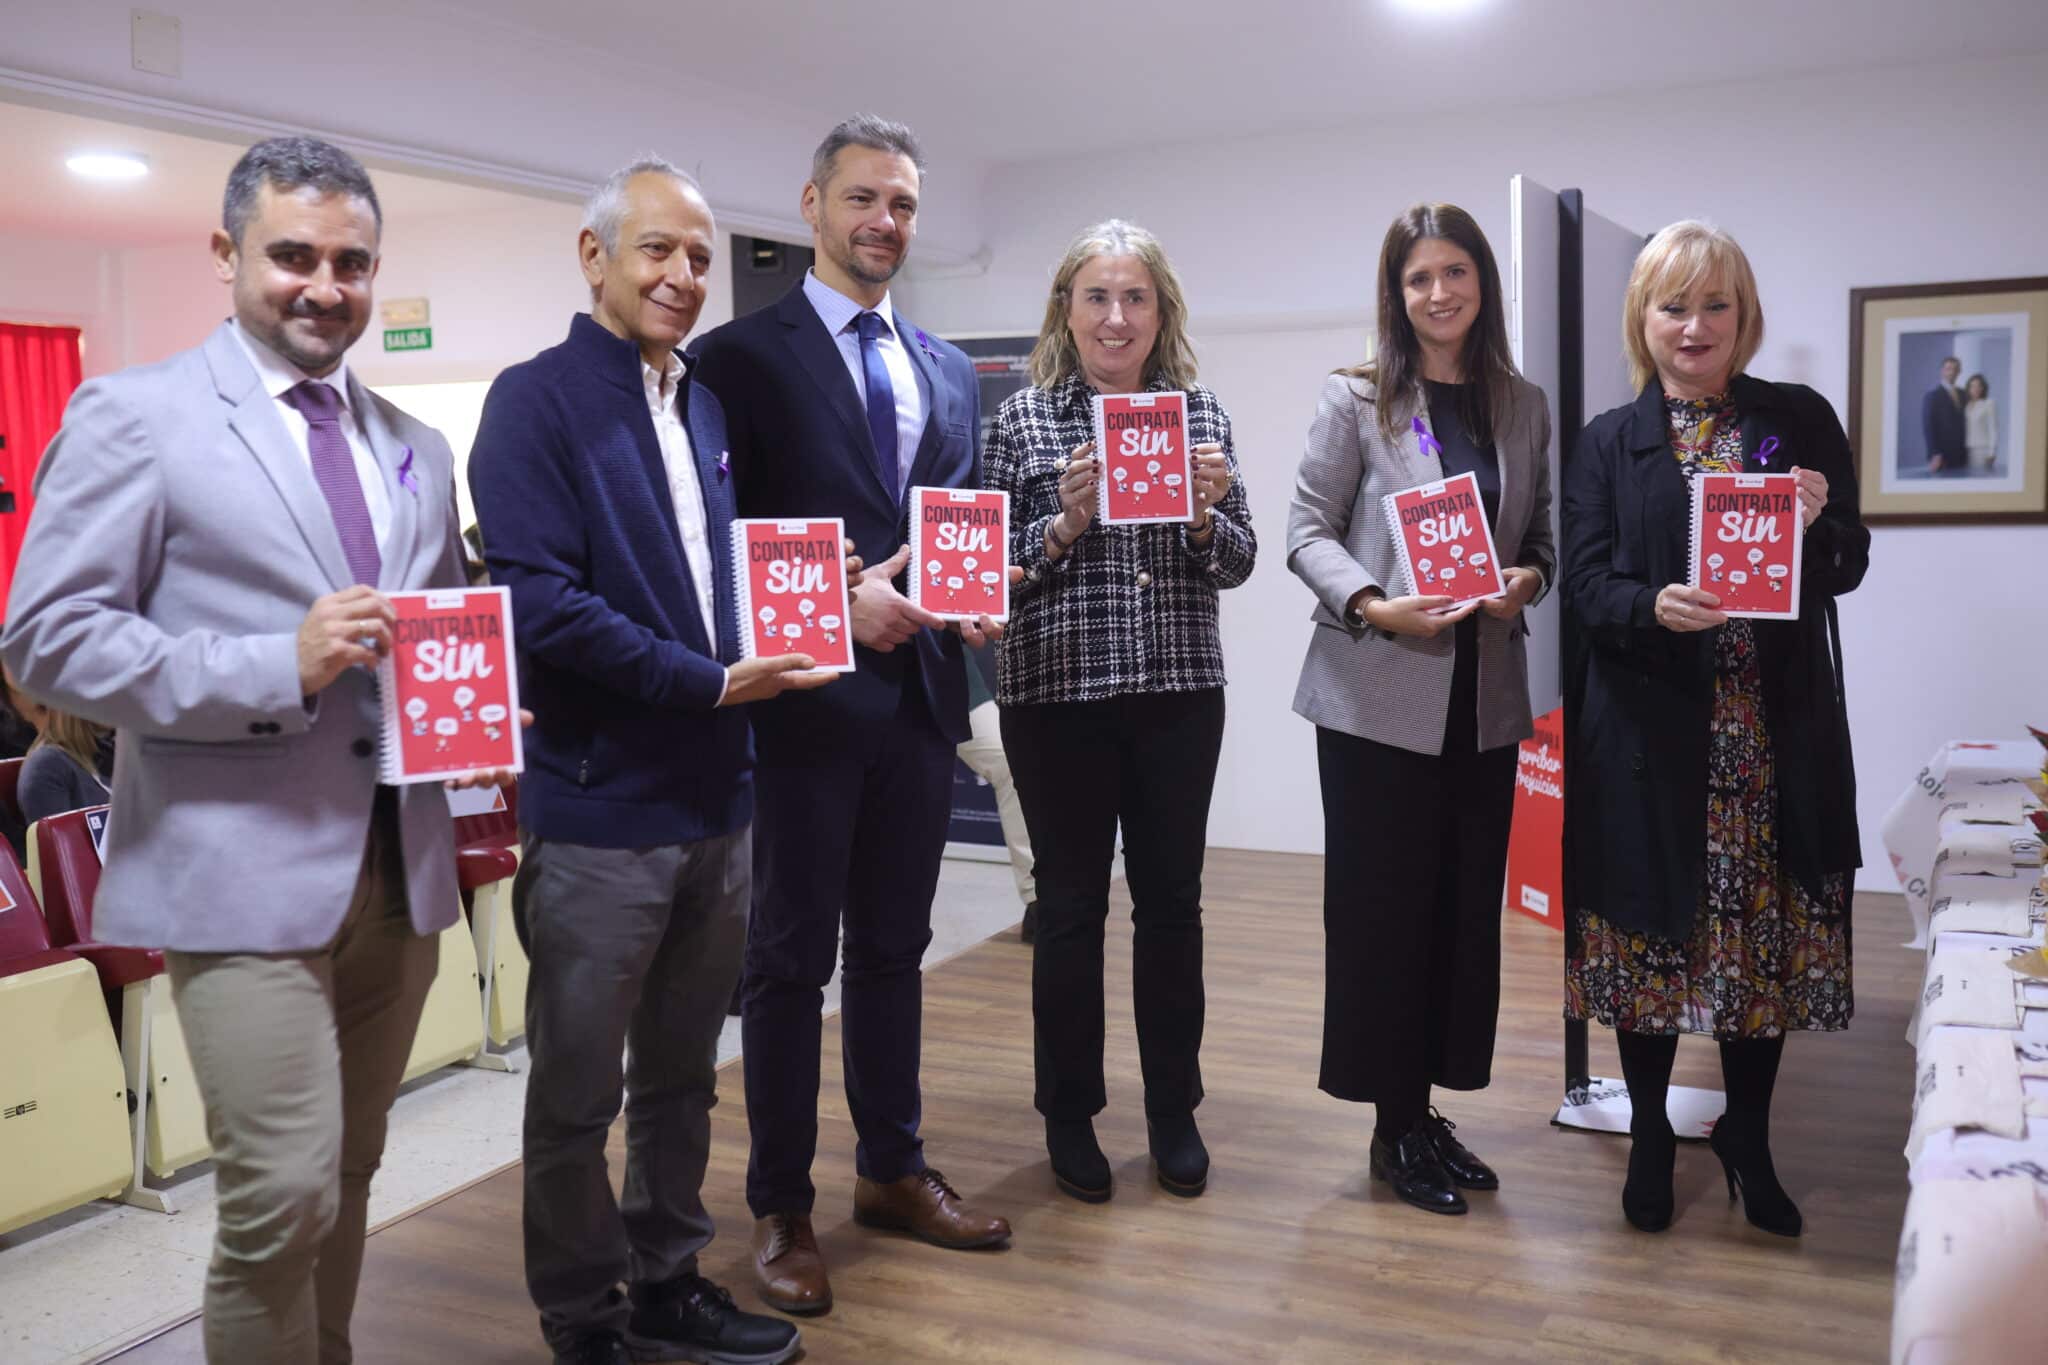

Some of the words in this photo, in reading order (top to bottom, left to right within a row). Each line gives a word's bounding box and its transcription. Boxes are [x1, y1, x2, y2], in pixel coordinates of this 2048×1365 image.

[386, 331, 427, 349] SALIDA
[1106, 411, 1180, 431] CONTRATA
[1119, 425, 1175, 457] Sin
[924, 505, 1001, 526] CONTRATA
[1401, 491, 1475, 526] CONTRATA
[1706, 493, 1792, 513] CONTRATA
[935, 520, 993, 553] Sin
[1418, 512, 1473, 547] Sin
[1717, 508, 1782, 544] Sin
[751, 540, 836, 562] CONTRATA
[765, 556, 831, 595] Sin
[395, 613, 501, 645] CONTRATA
[412, 635, 495, 683] Sin
